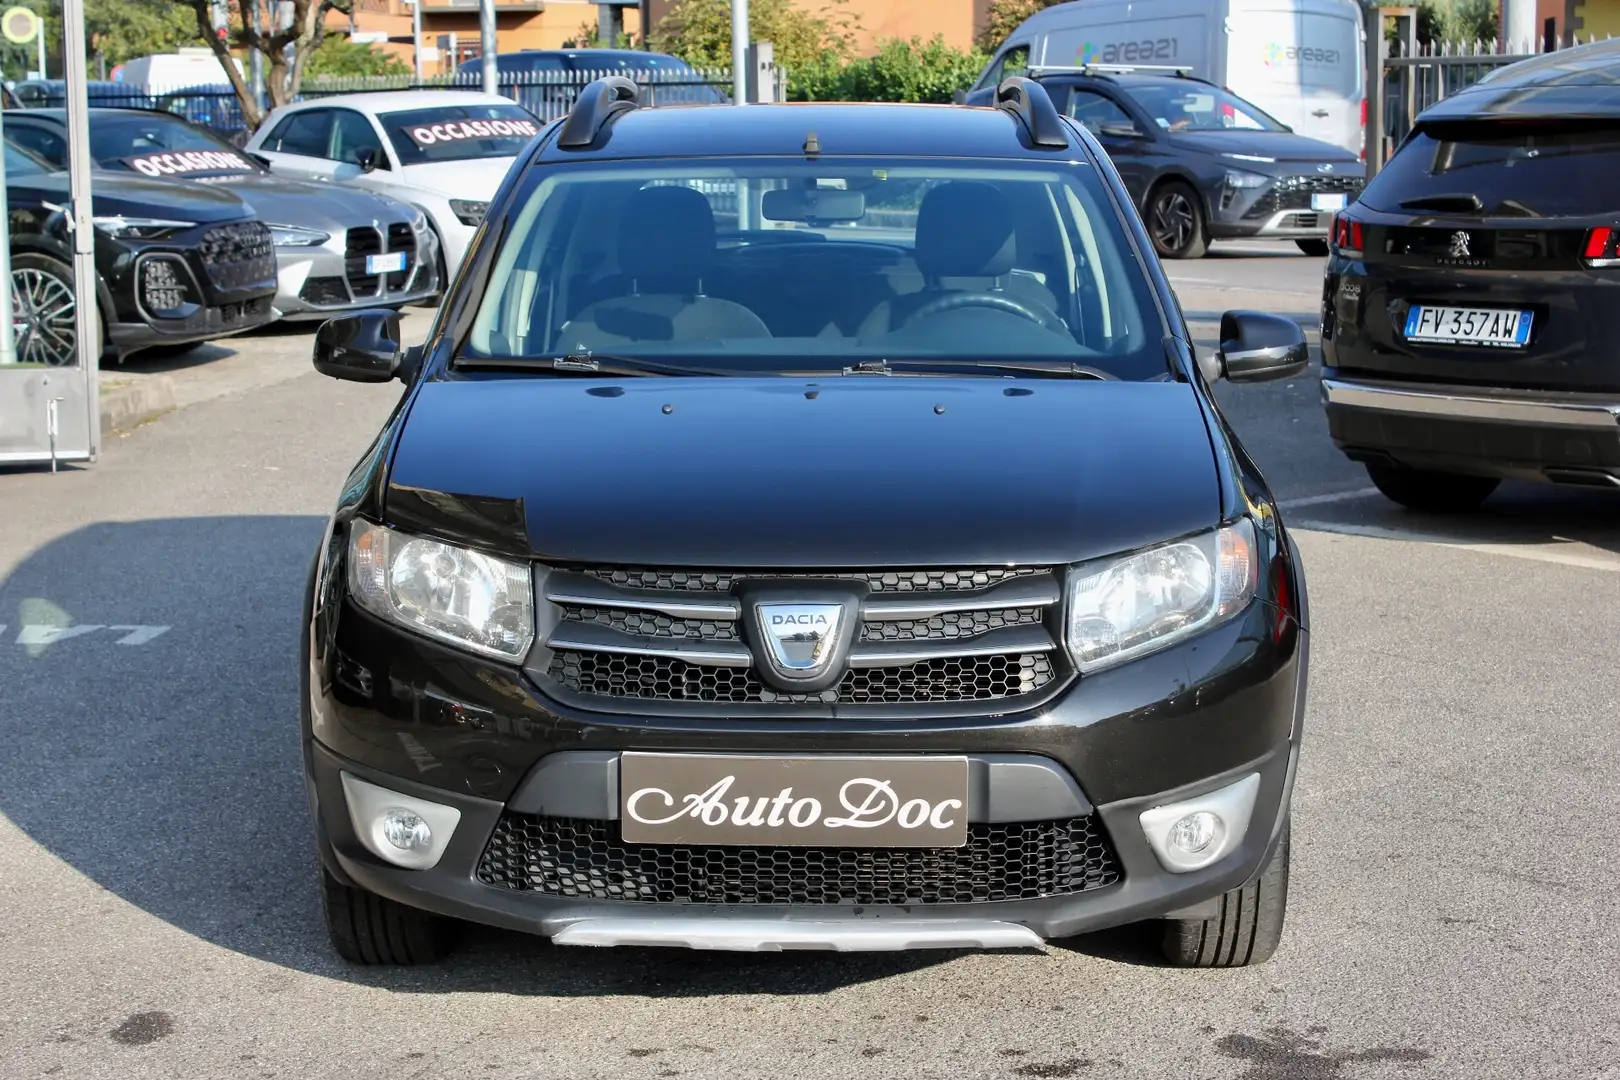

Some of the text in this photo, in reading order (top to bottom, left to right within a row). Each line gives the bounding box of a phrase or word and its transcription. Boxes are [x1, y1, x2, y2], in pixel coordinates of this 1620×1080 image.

[1102, 38, 1178, 63] area21
[1285, 45, 1340, 64] area21
[413, 119, 537, 145] OCCASIONE
[133, 150, 252, 177] OCCASIONE
[1418, 308, 1517, 339] FV 357AW
[771, 614, 828, 625] DACIA
[626, 775, 963, 829] Auto Doc
